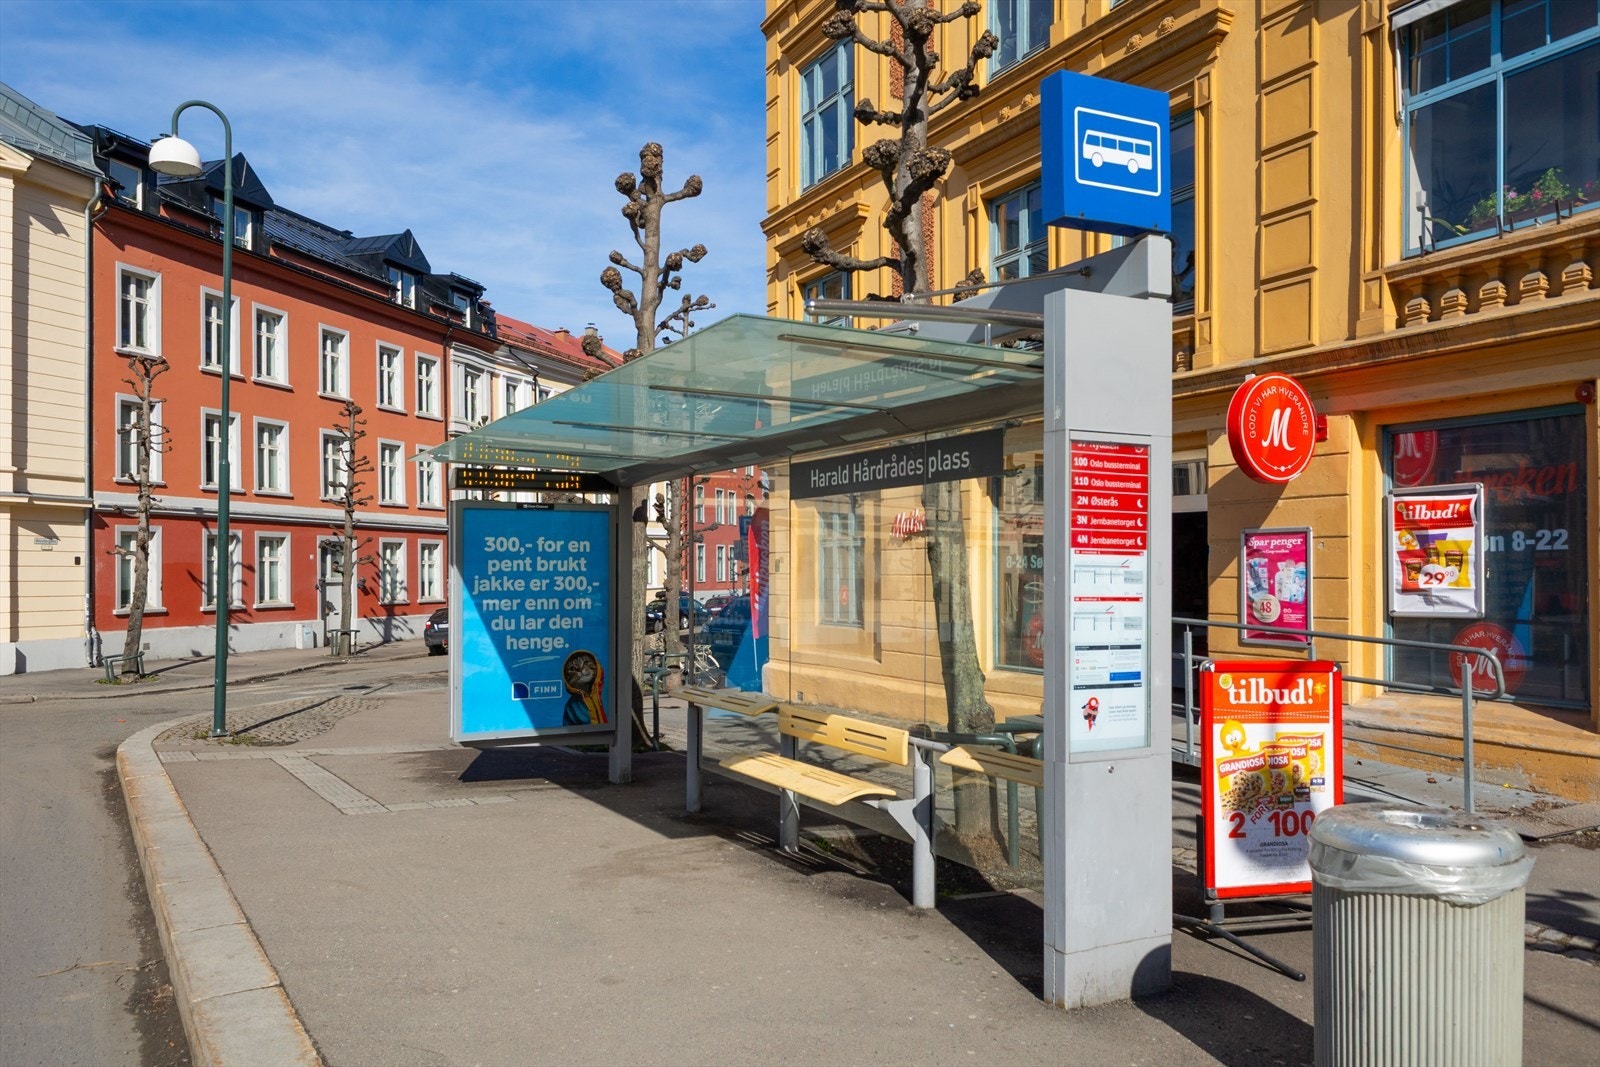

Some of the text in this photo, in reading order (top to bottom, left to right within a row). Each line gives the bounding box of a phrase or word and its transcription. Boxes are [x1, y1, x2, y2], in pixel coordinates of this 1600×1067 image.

[1248, 386, 1308, 438] GODT VI HAR HVERANDRE
[1262, 407, 1296, 451] M
[810, 450, 970, 488] Harald Hårdrådes plass
[1074, 457, 1141, 470] 100 Oslo bussterminal
[1074, 476, 1142, 488] 110 Oslo bussterminal
[1077, 496, 1118, 506] 2N Østerås
[1402, 503, 1460, 520] tilbud!
[1076, 515, 1136, 528] 3N Jernbanetorget
[484, 536, 590, 555] 300,- for en
[1077, 534, 1136, 546] 4N Jernbanetorget
[1249, 537, 1302, 550] Spar penger
[1512, 528, 1568, 552] 8-22
[488, 556, 587, 575] pent brukt
[472, 575, 600, 595] jakke er 300,-
[1423, 572, 1445, 584] 29
[482, 597, 592, 611] mer enn om
[1260, 602, 1272, 612] 48
[491, 614, 583, 630] du lar den
[1470, 630, 1486, 640] HAR
[506, 635, 570, 652] henge.
[534, 686, 557, 694] FINN
[1228, 678, 1314, 704] tilbud!
[1220, 756, 1265, 772] GRANDIOSA
[1229, 806, 1316, 838] 2 FOR 100
